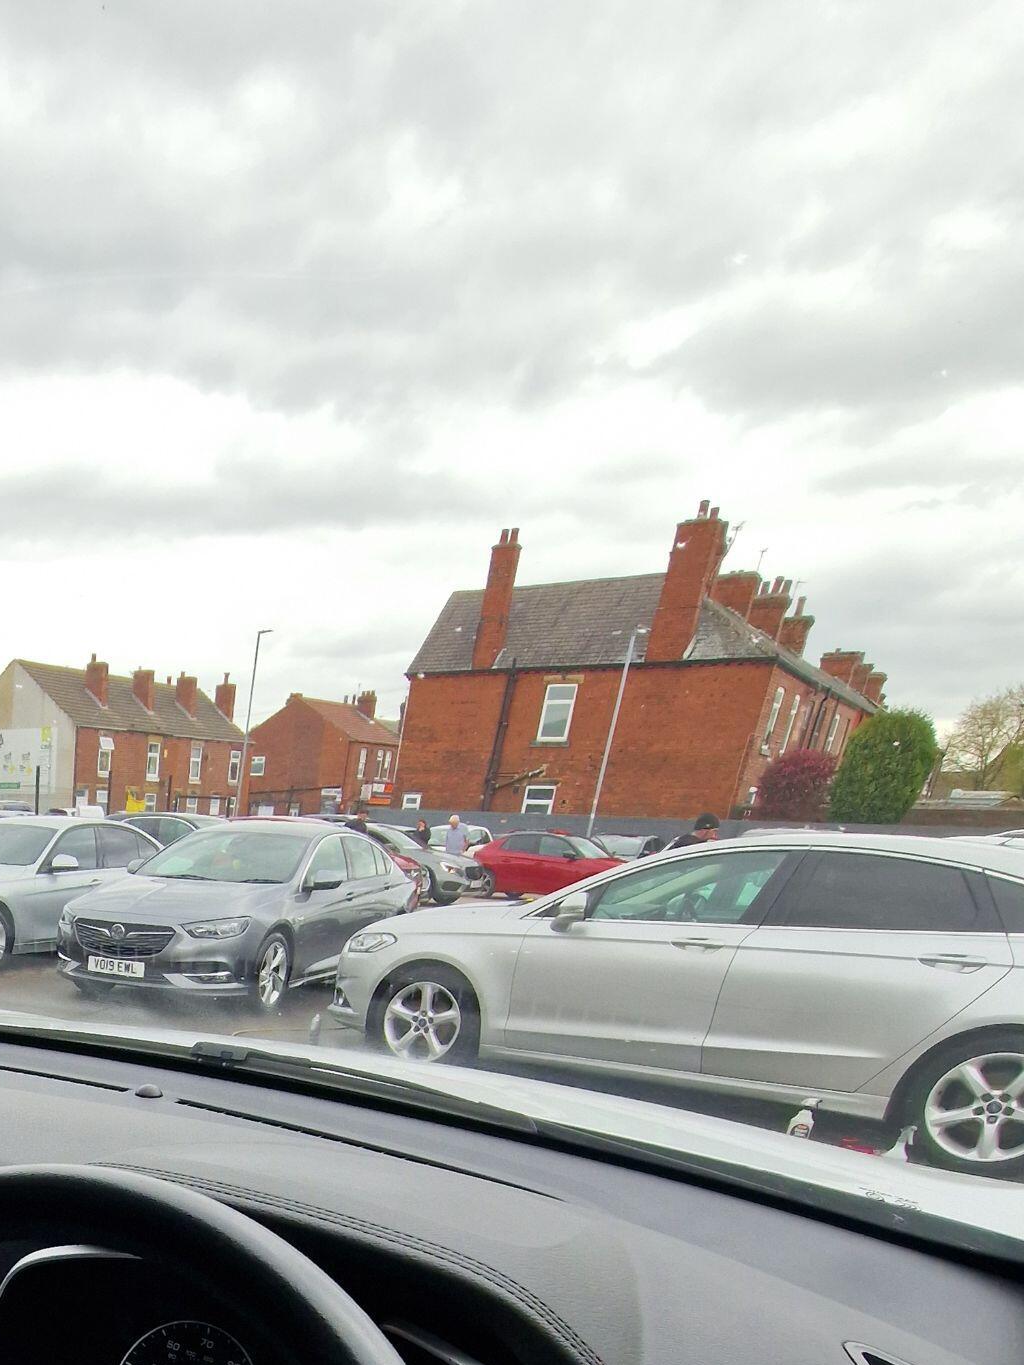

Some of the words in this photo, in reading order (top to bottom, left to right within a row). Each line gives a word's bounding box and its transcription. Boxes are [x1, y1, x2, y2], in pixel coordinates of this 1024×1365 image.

[117, 961, 137, 975] EWL
[166, 1339, 180, 1351] 50
[200, 1337, 214, 1349] 70
